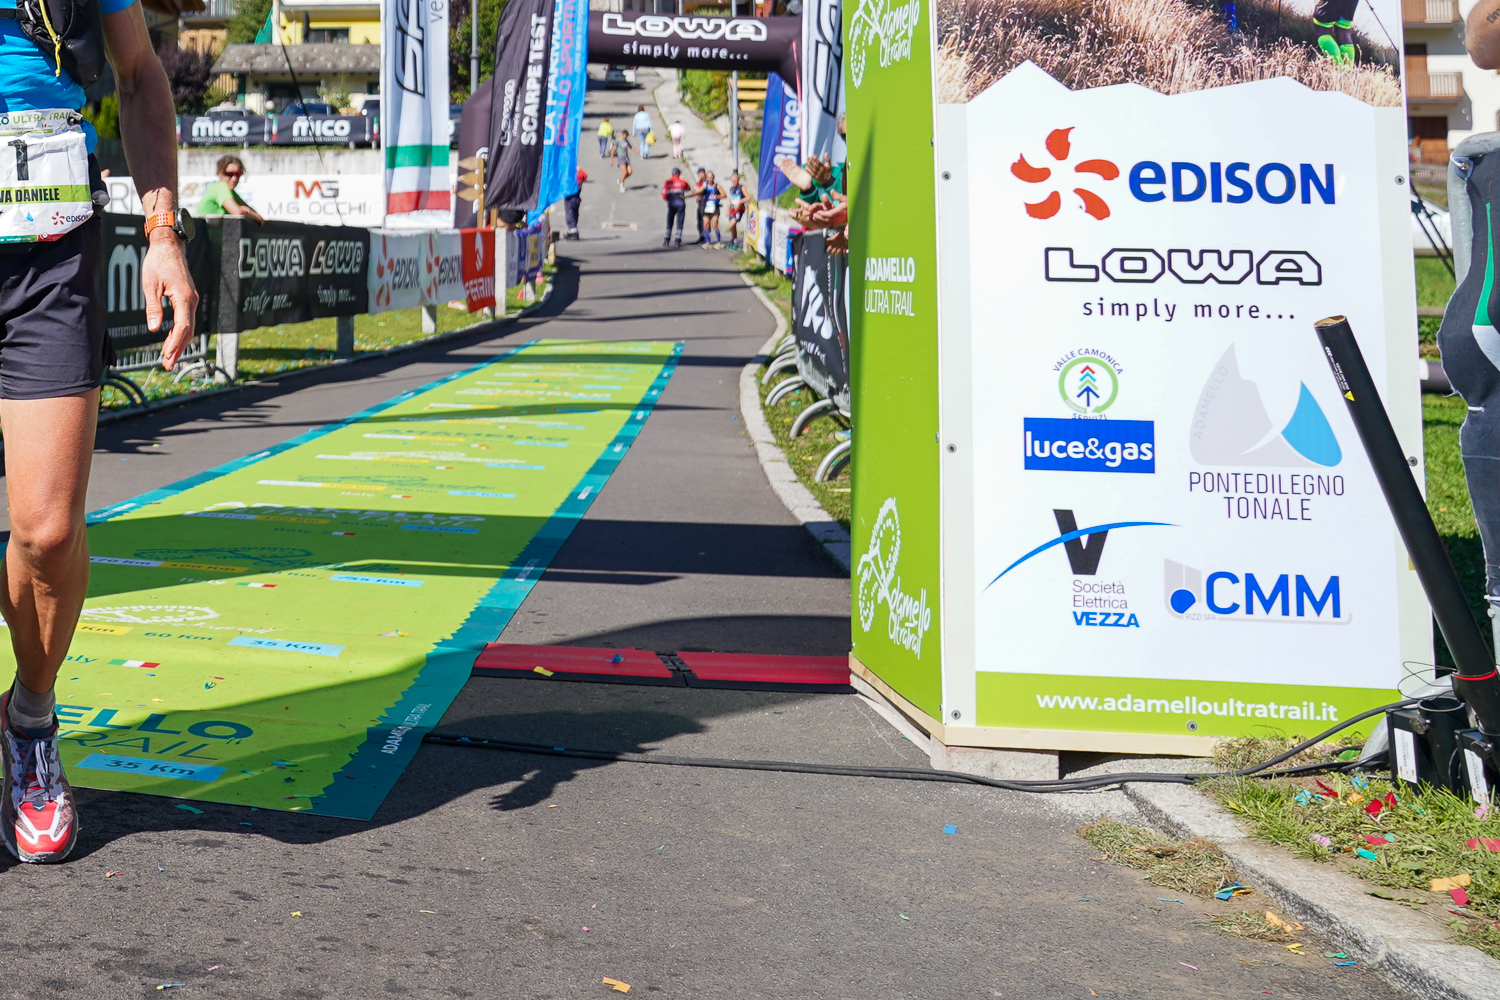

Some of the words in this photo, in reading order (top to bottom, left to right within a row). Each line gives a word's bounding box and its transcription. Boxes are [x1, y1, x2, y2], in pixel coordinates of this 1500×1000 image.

[529, 12, 547, 63] TEST
[602, 12, 768, 42] LOWA
[622, 40, 680, 60] simply
[687, 46, 749, 60] more...
[520, 64, 544, 146] SCARPE
[12, 114, 46, 125] ULTRA
[7, 139, 29, 181] 1
[15, 187, 60, 203] DANIELE
[238, 237, 306, 279] LOWA
[309, 240, 364, 275] LOWA
[864, 256, 916, 283] ADAMELLO
[1044, 247, 1322, 286] LOWA
[464, 275, 495, 301] FERRIN
[864, 289, 890, 314] ULTRA
[890, 289, 915, 317] TRAIL
[1082, 297, 1177, 322] simply
[1193, 303, 1295, 320] more...
[1052, 350, 1076, 372] VALLE
[1077, 348, 1123, 375] CAMONICA
[1194, 365, 1229, 439] ADAMELLO
[1025, 431, 1154, 468] luce&gas
[1189, 471, 1345, 496] PONTEDILEGNO
[1223, 496, 1312, 521] TONALE
[1072, 579, 1126, 595] Società
[1206, 571, 1341, 619] CMM
[1072, 594, 1129, 610] Elettrica
[1072, 610, 1140, 628] VEZZA
[1184, 612, 1203, 621] RIZZI
[1203, 613, 1217, 622] SPA
[249, 639, 279, 647] 35
[284, 642, 322, 652] Km
[1036, 691, 1339, 721] www.adamelloultratrail.it
[57, 728, 220, 761] RAIL
[106, 759, 144, 772] 35
[150, 762, 196, 776] Km
